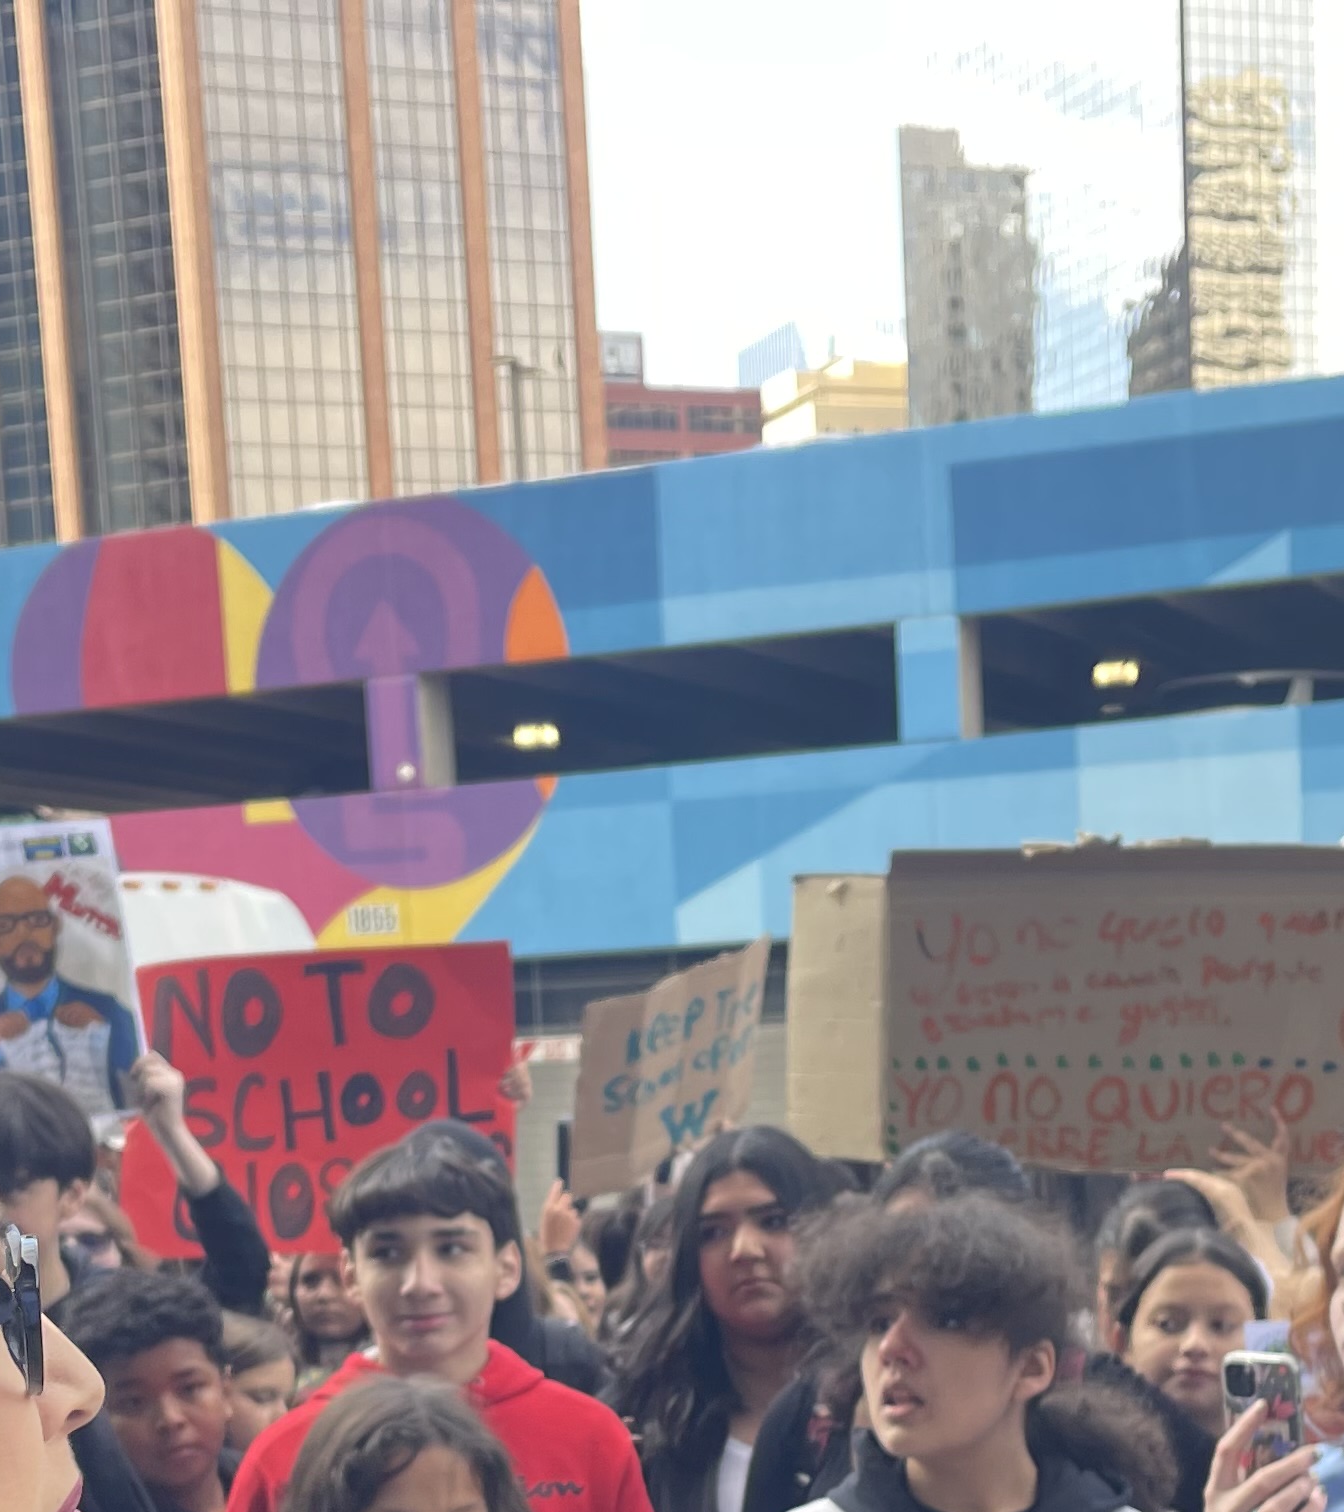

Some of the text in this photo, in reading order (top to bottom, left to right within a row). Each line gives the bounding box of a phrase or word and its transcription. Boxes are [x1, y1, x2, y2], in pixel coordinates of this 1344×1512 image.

[151, 960, 436, 1062] NO TO
[183, 1048, 495, 1152] SCHOOL
[893, 1074, 963, 1127] YO
